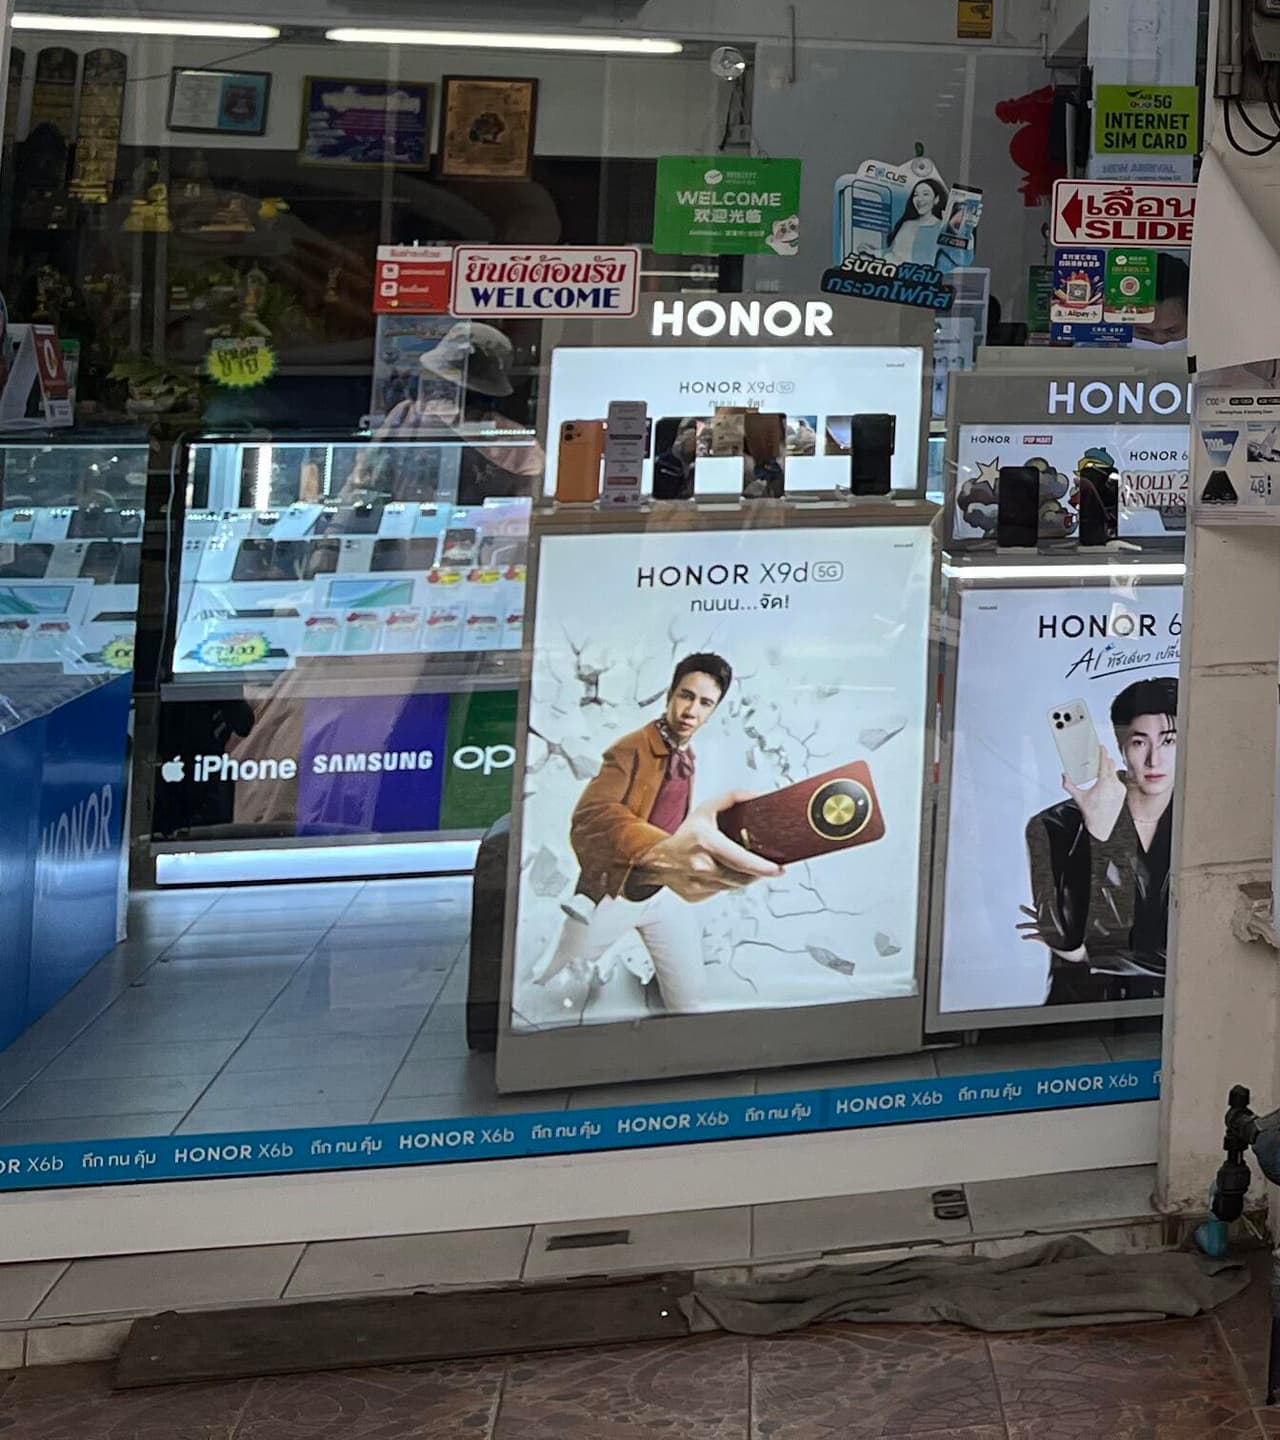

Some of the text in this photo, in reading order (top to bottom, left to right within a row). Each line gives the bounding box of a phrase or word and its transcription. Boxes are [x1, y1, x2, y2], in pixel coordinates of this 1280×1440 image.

[1153, 94, 1173, 110] 5G
[1104, 111, 1191, 131] INTERNET
[1103, 132, 1188, 150] SIM CARD
[865, 164, 908, 185] FOCUS
[675, 190, 782, 207] WELCOME
[1087, 186, 1196, 219] เลื่อน
[693, 208, 763, 224] 欢迎光临
[1084, 219, 1194, 241] SLIDE
[465, 255, 627, 285] ยินดีต้อนรับ
[470, 287, 621, 310] WELCOME
[651, 300, 835, 338] HONOR
[678, 379, 776, 394] HONOR X9d
[1048, 380, 1193, 415] HONO
[969, 434, 1011, 445] HONOR
[1129, 450, 1178, 461] HONOR
[1124, 473, 1176, 491] MOLLY
[636, 560, 811, 588] HONOR X9d
[1038, 614, 1157, 639] HONOR
[1064, 646, 1103, 679] AI
[193, 754, 298, 783] iPhone
[312, 749, 434, 775] SAMSUNG
[41, 782, 113, 863] HONOR
[27, 1156, 64, 1172] X6b
[174, 1146, 253, 1164] HONOR
[258, 1140, 294, 1159] X6b
[399, 1130, 476, 1150] HONOR
[480, 1125, 516, 1145] X6b
